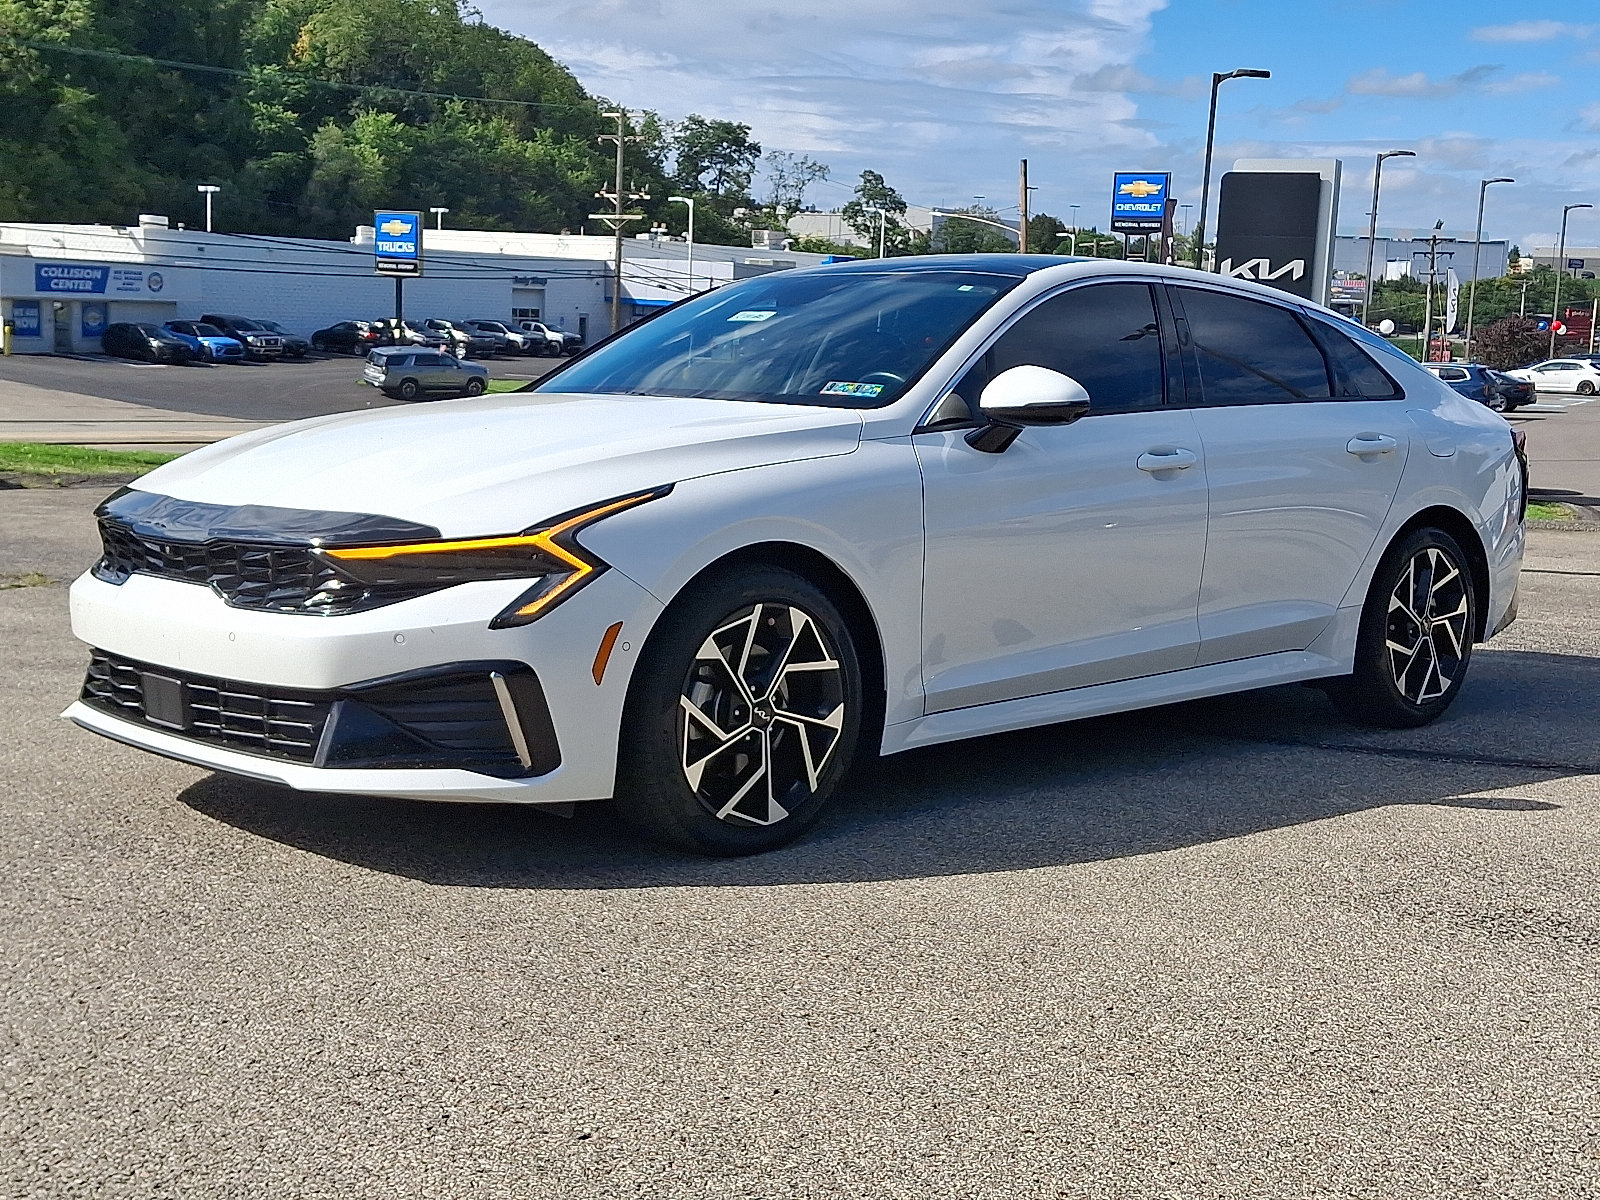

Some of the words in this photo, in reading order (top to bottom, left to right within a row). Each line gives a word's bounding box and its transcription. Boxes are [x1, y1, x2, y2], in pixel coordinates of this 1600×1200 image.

[1116, 203, 1161, 211] CHEVROLET
[377, 242, 415, 252] TRUCKS
[41, 267, 102, 278] COLLISION
[1220, 258, 1305, 281] KIA
[50, 279, 93, 290] CENTER
